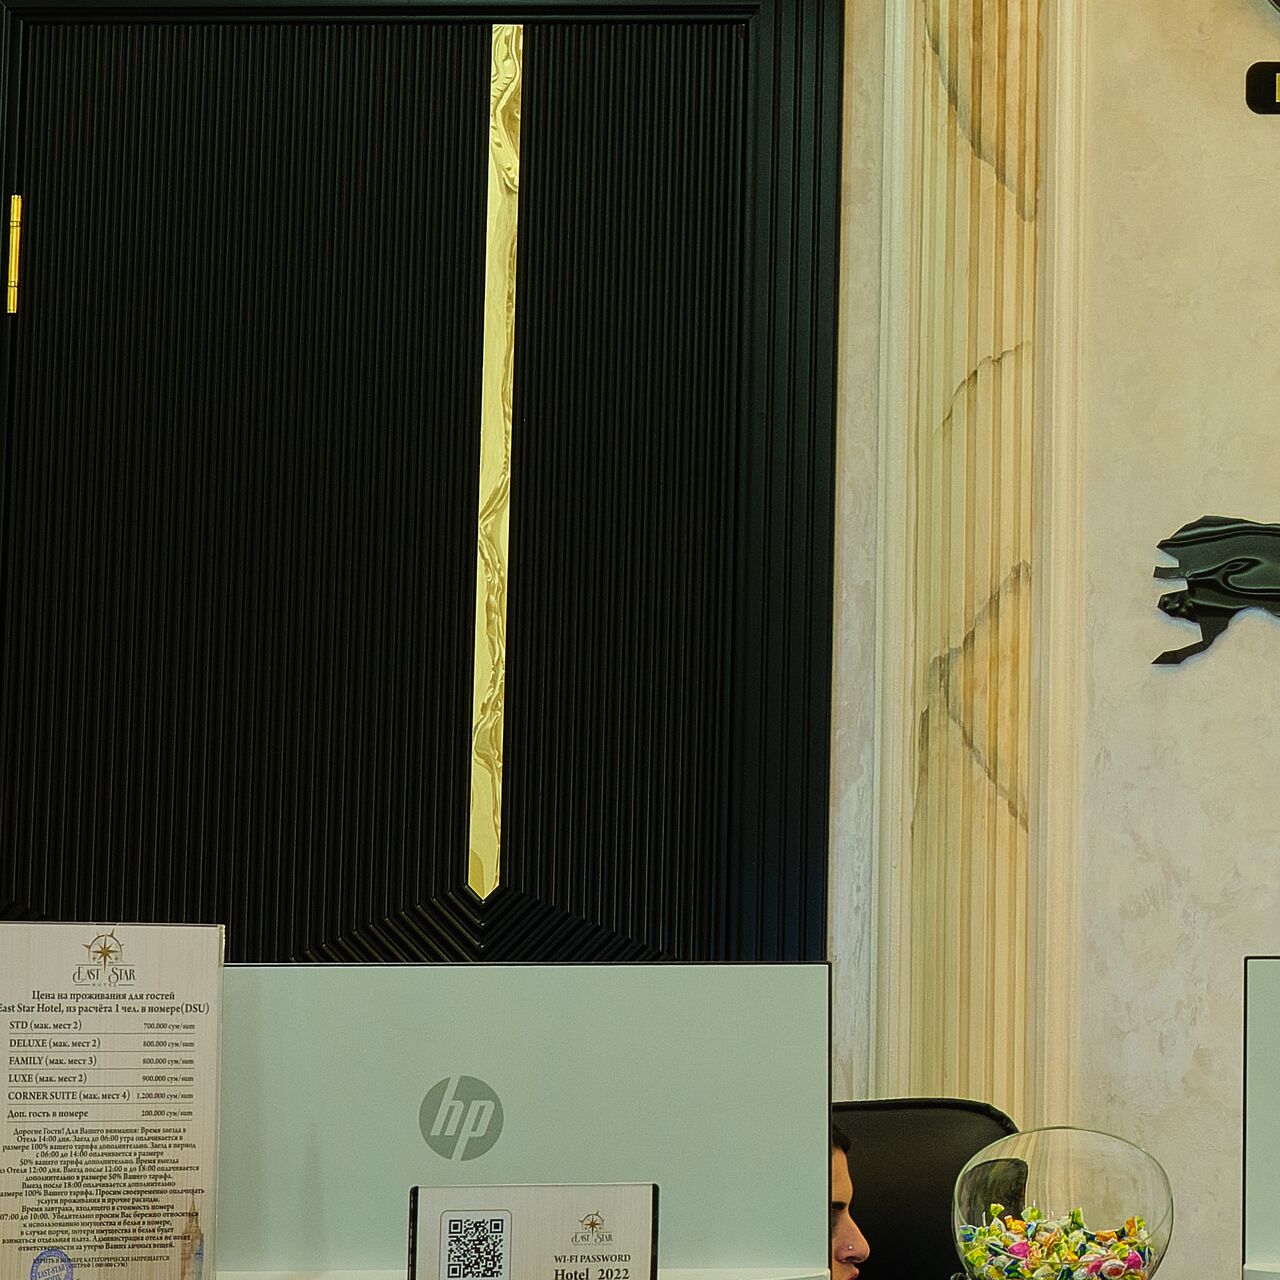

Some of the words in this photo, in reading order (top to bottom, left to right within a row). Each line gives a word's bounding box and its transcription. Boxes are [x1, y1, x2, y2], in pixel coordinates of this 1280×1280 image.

[32, 990, 55, 1001] Цена
[70, 993, 127, 1002] проживания
[128, 993, 144, 1001] для
[146, 992, 175, 1000] гостей
[17, 1003, 35, 1013] Star
[37, 1003, 64, 1014] Hotel,
[78, 1004, 112, 1015] расчёта
[9, 1021, 28, 1029] STD
[73, 1020, 82, 1031] 2)
[9, 1039, 47, 1048] DELUXE
[91, 1037, 101, 1049] 2)
[9, 1056, 44, 1065] FAMILY
[88, 1055, 97, 1067] 3)
[8, 1074, 33, 1082] LUXE
[78, 1072, 87, 1084] 2)
[8, 1091, 48, 1100] CORNER
[49, 1091, 77, 1100] SUITE
[121, 1089, 130, 1101] 4)
[7, 1110, 27, 1119] Доп.
[58, 1111, 88, 1120] номере
[430, 1075, 495, 1160] hp
[554, 1254, 578, 1263] WI-FI
[580, 1254, 631, 1263] PASSWORD
[554, 1268, 590, 1280] Hotel
[598, 1268, 630, 1280] 2022
